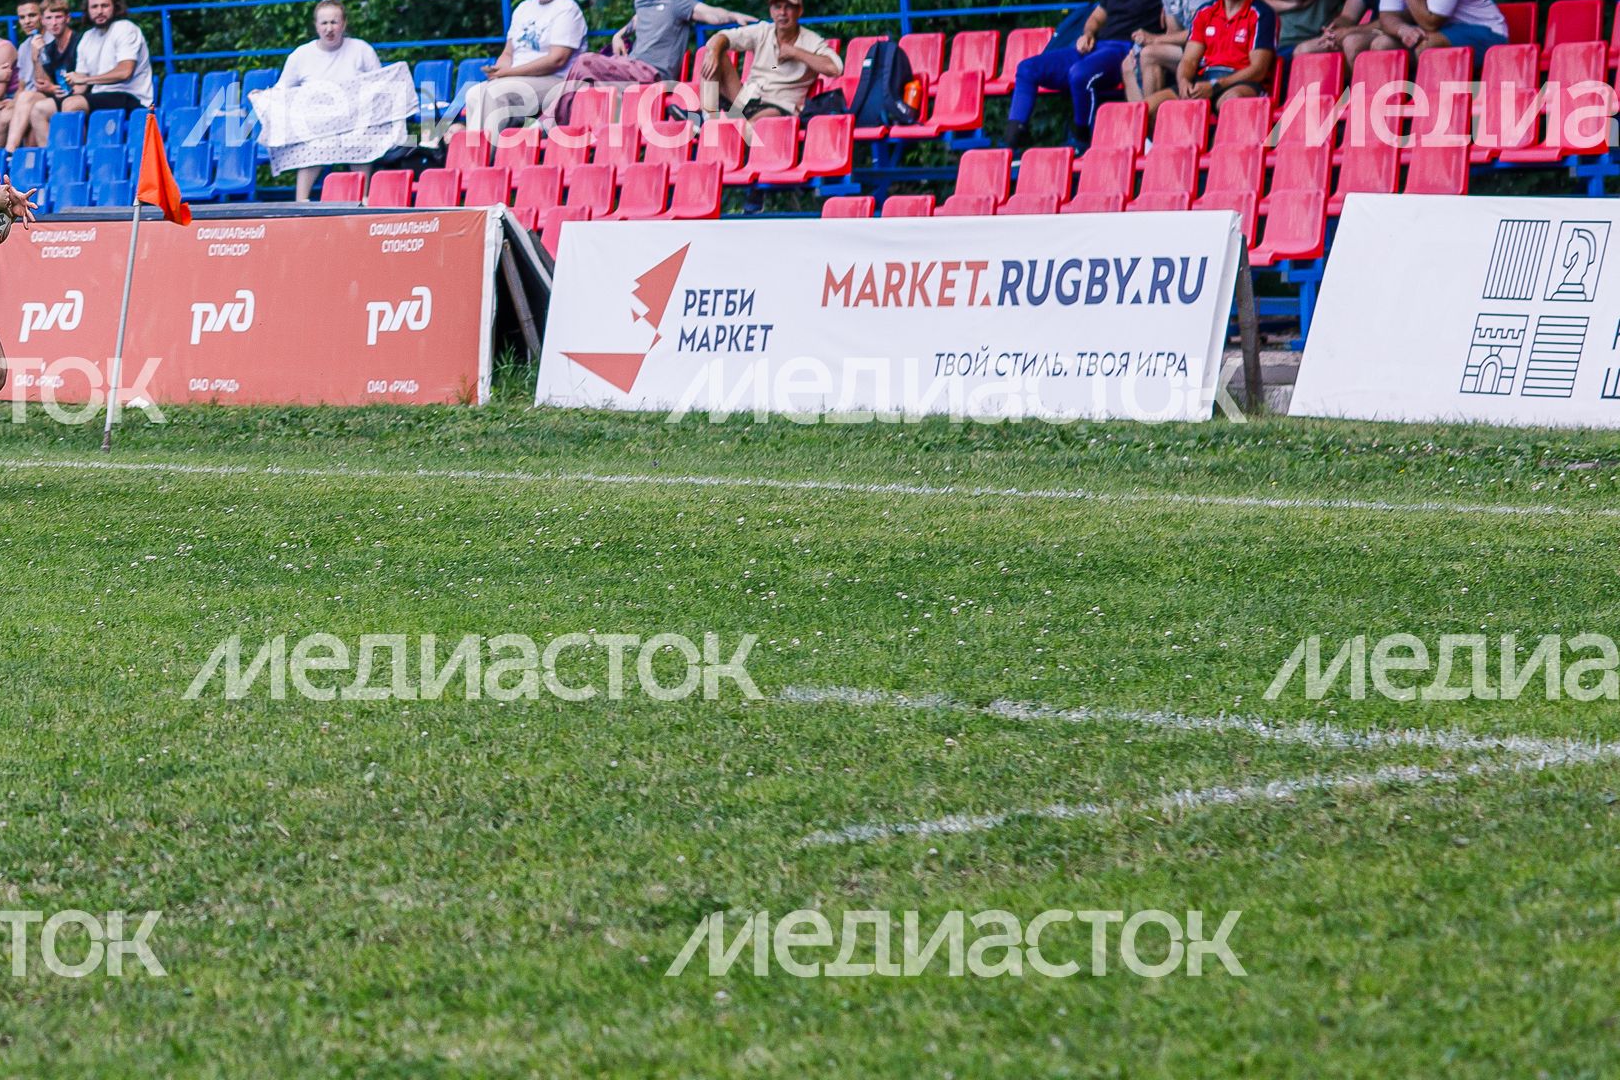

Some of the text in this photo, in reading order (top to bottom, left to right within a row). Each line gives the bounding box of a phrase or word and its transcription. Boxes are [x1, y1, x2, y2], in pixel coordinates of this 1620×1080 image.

[196, 224, 265, 240] ОФИЦИАЛЬНЫЙ
[369, 217, 440, 236] ОФИЦИАЛЬНЫЙ
[31, 227, 97, 243] ОФИЦИАЛЬНЫЙ
[41, 246, 82, 259] СПОНСОР
[208, 243, 251, 256] СПОНСОР
[381, 238, 425, 253] СПОНСОР
[821, 256, 1208, 308] MARKET.RUGBY.RU
[683, 289, 756, 317] РЕГБИ
[678, 325, 774, 352] МАРКЕТ
[934, 345, 1188, 377] ТВОЙ СТИЛЬ. ТВОЯ ИГРА
[189, 378, 209, 391] ОАО
[367, 380, 388, 393] ОАО
